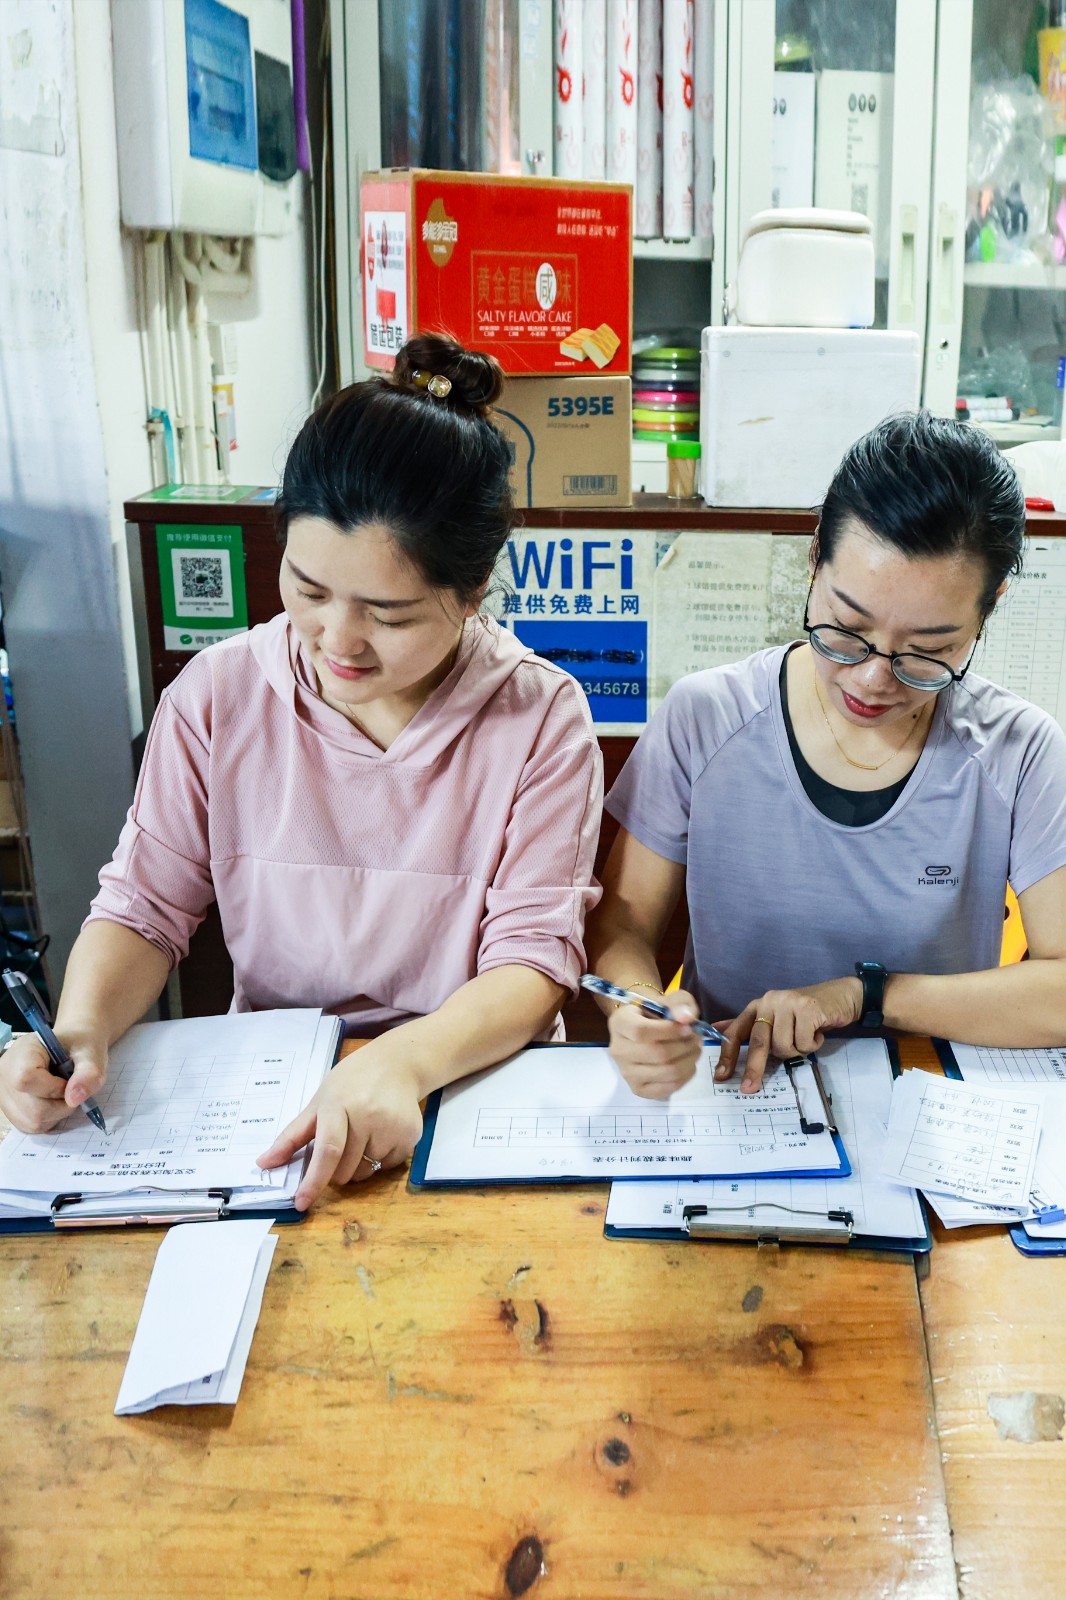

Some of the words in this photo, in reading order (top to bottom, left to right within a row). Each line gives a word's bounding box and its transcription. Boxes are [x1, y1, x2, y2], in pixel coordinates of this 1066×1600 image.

[477, 310, 506, 323] SALTY
[509, 310, 546, 323] FLAVOR
[548, 310, 572, 323] CAKE
[547, 396, 614, 417] 5395E
[507, 538, 633, 590] WiFi
[503, 594, 640, 615] 提供免费上网
[581, 682, 640, 695] 345678
[918, 877, 959, 887] Kalenji
[592, 1155, 693, 1163] 趣味赛裁判计分表
